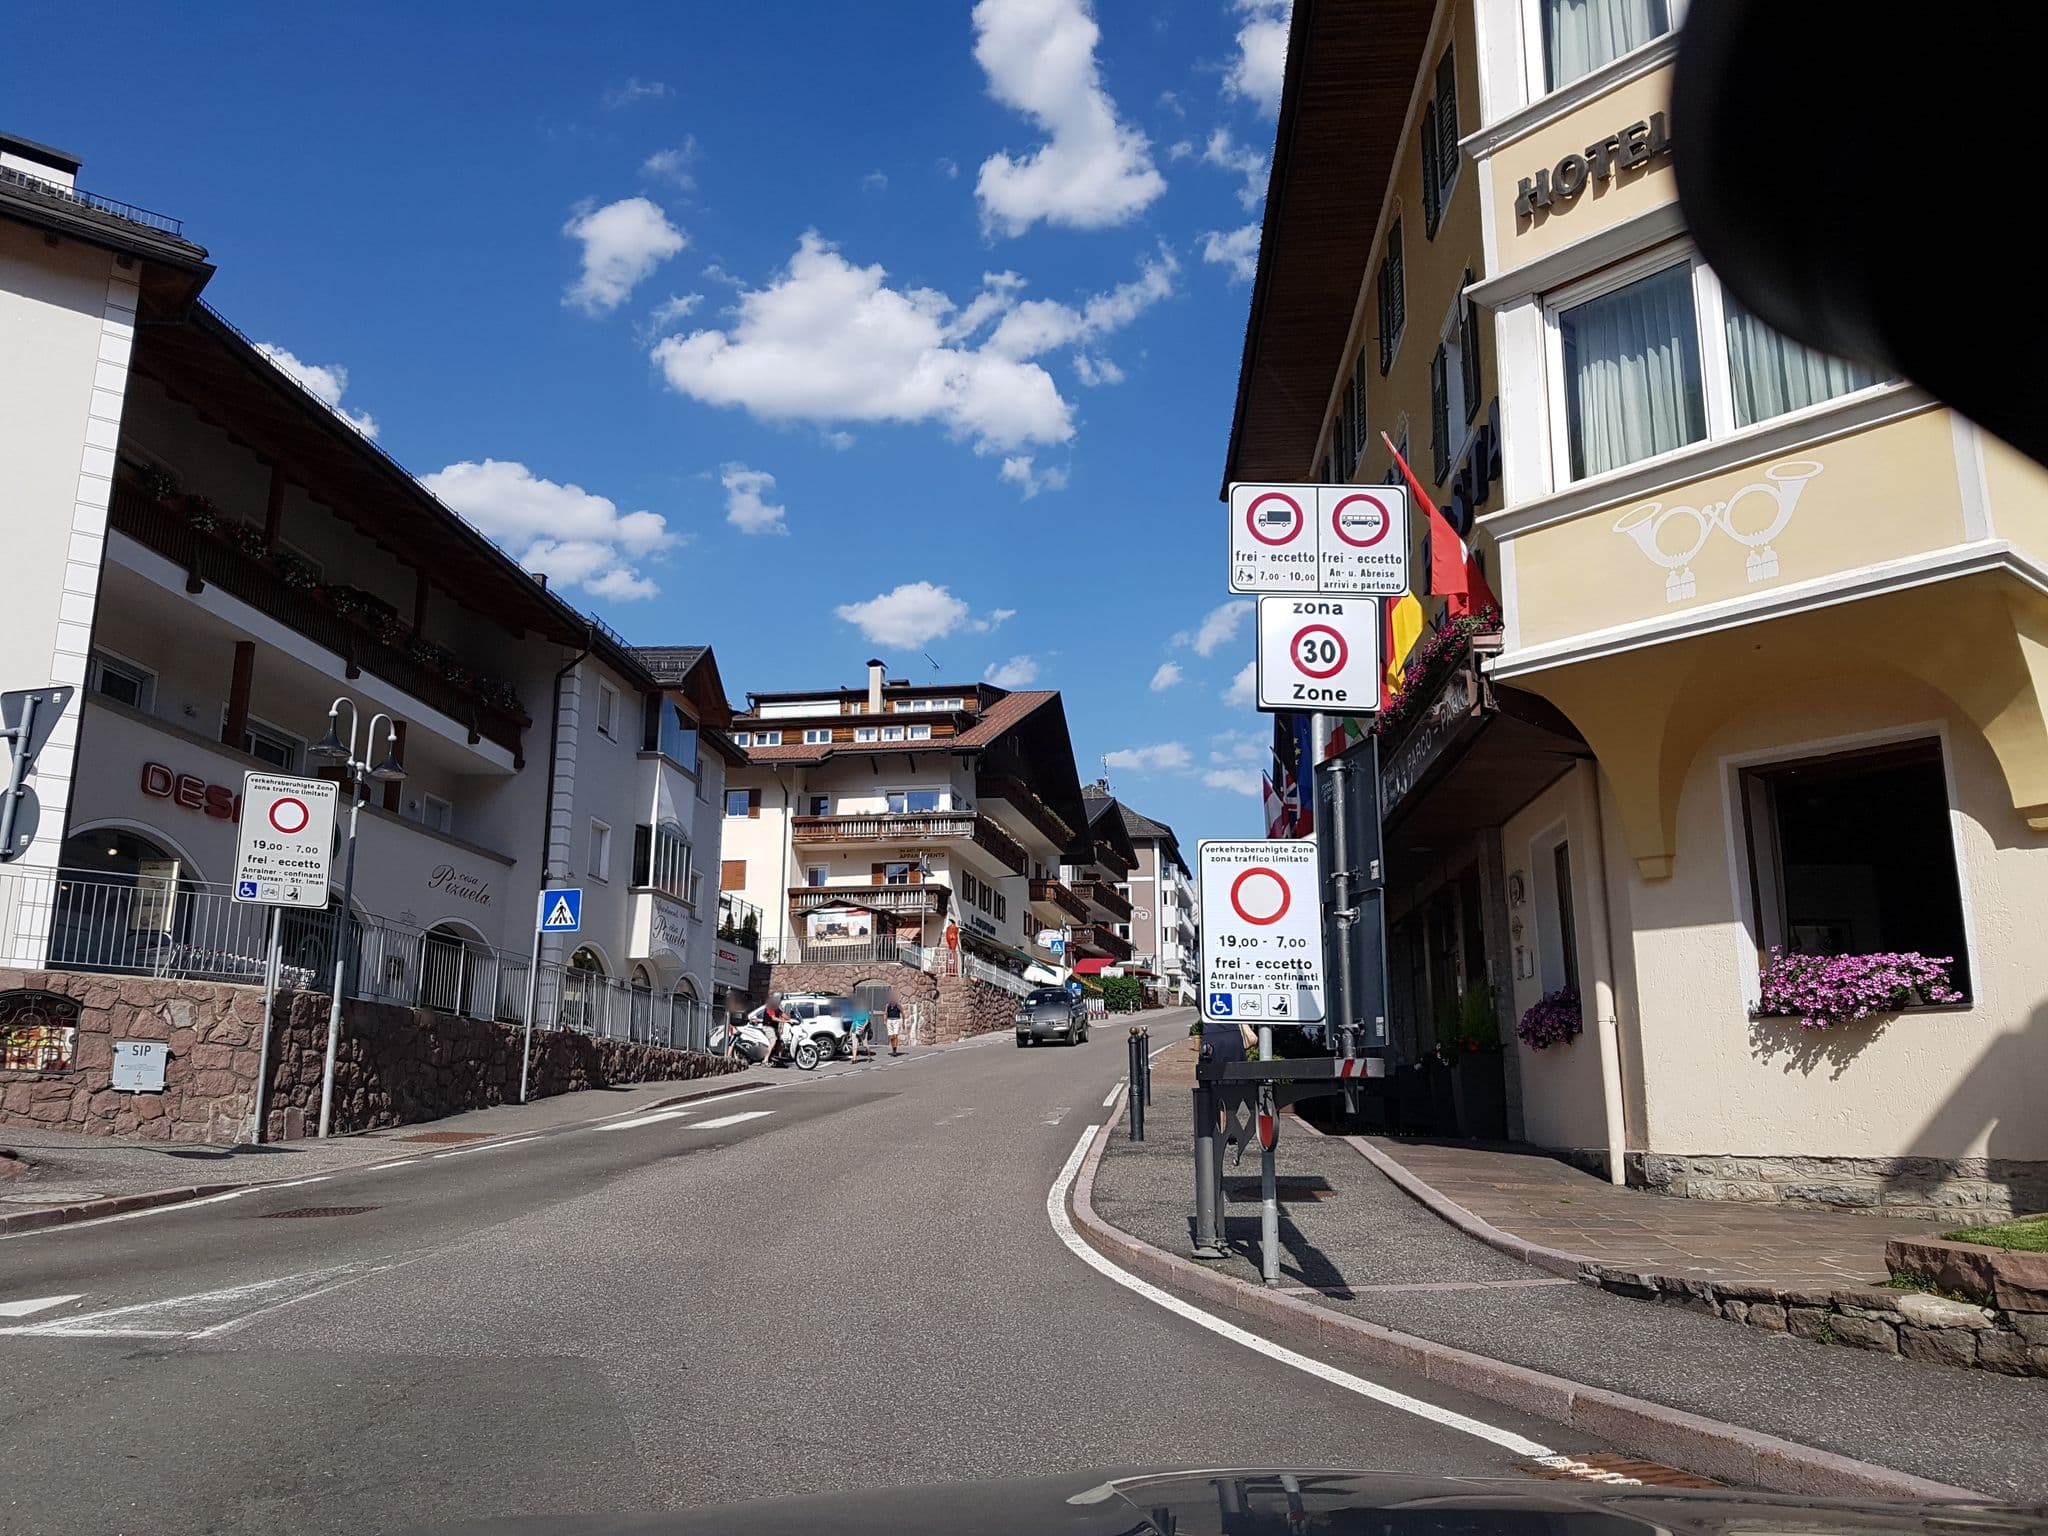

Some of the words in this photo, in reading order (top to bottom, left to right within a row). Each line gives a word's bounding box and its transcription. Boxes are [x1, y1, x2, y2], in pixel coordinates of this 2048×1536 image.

[1514, 111, 1672, 217] HOTEL
[1236, 550, 1257, 562] frei
[1271, 552, 1315, 562] eccetto
[1322, 552, 1344, 563] frei
[1358, 553, 1402, 564] eccetto
[1330, 568, 1344, 576] An-
[1361, 568, 1394, 578] Abreise
[1324, 580, 1348, 588] arrivi
[1361, 581, 1400, 591] partenze
[1293, 602, 1344, 615] zona
[1304, 640, 1336, 664] 30
[1293, 684, 1347, 702] Zone
[1408, 728, 1432, 770] PARCO
[251, 778, 314, 789] verkehrsberuhigte
[141, 762, 242, 824] DES
[272, 786, 299, 794] traffico
[301, 790, 328, 798] limitato
[1205, 846, 1289, 854] verkehrsberuhigte
[248, 854, 267, 864] frei
[278, 859, 320, 869] eccetto
[242, 866, 276, 875] Anrainer
[284, 871, 324, 879] confinanti
[428, 864, 490, 904] Pizuela
[1216, 957, 1240, 968] frei
[1256, 958, 1312, 969] eccetto
[1210, 972, 1255, 980] Anrainer
[1265, 972, 1318, 981] confinanti
[1296, 982, 1320, 991] Iman
[132, 1045, 152, 1056] SIP
